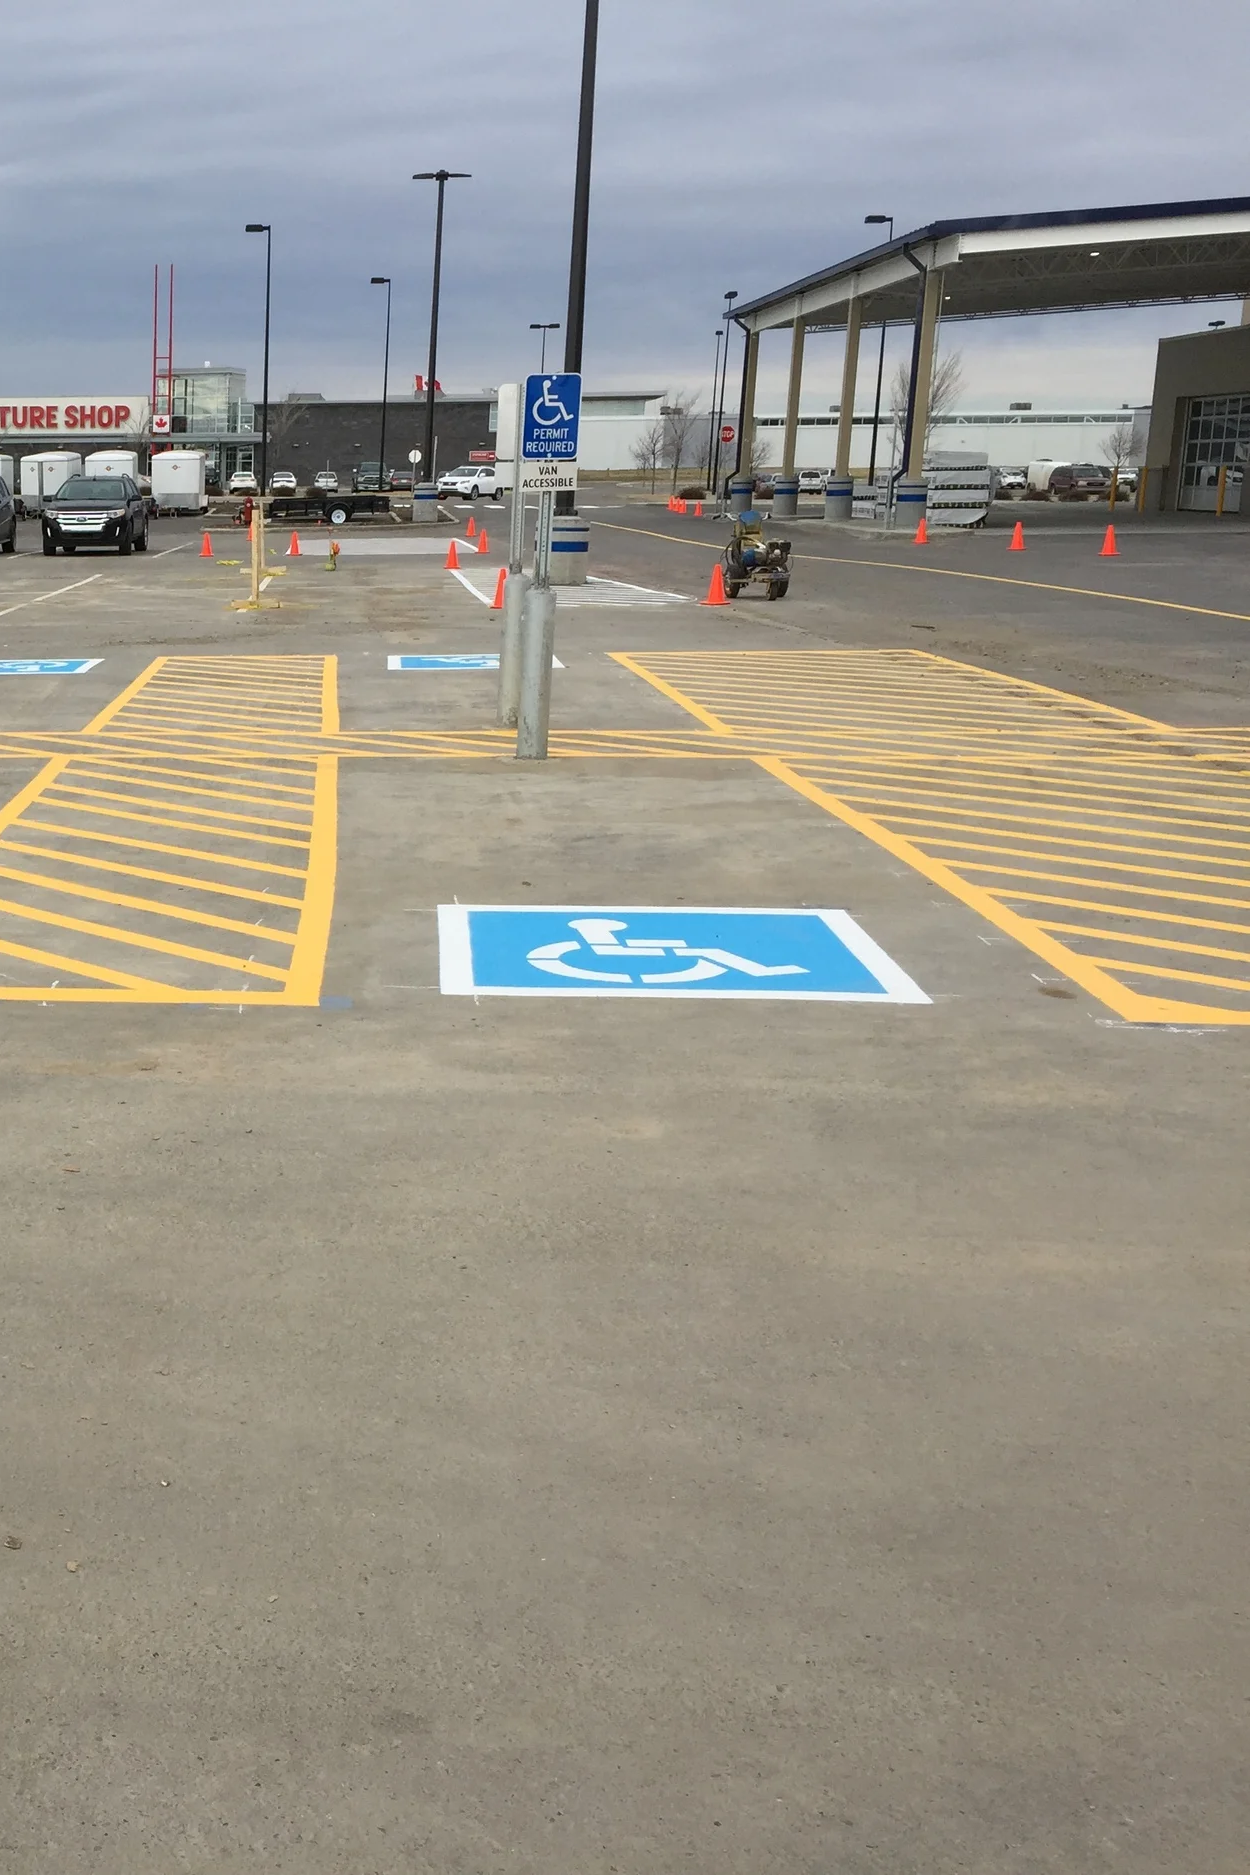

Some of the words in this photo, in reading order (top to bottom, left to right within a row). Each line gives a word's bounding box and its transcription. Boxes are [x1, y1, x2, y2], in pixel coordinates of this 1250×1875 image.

[64, 405, 131, 429] SHOP
[533, 427, 569, 440] PERMIT
[525, 441, 575, 453] REQUIRED
[538, 465, 558, 476] VAN
[522, 477, 574, 489] ACCESSIBLE
